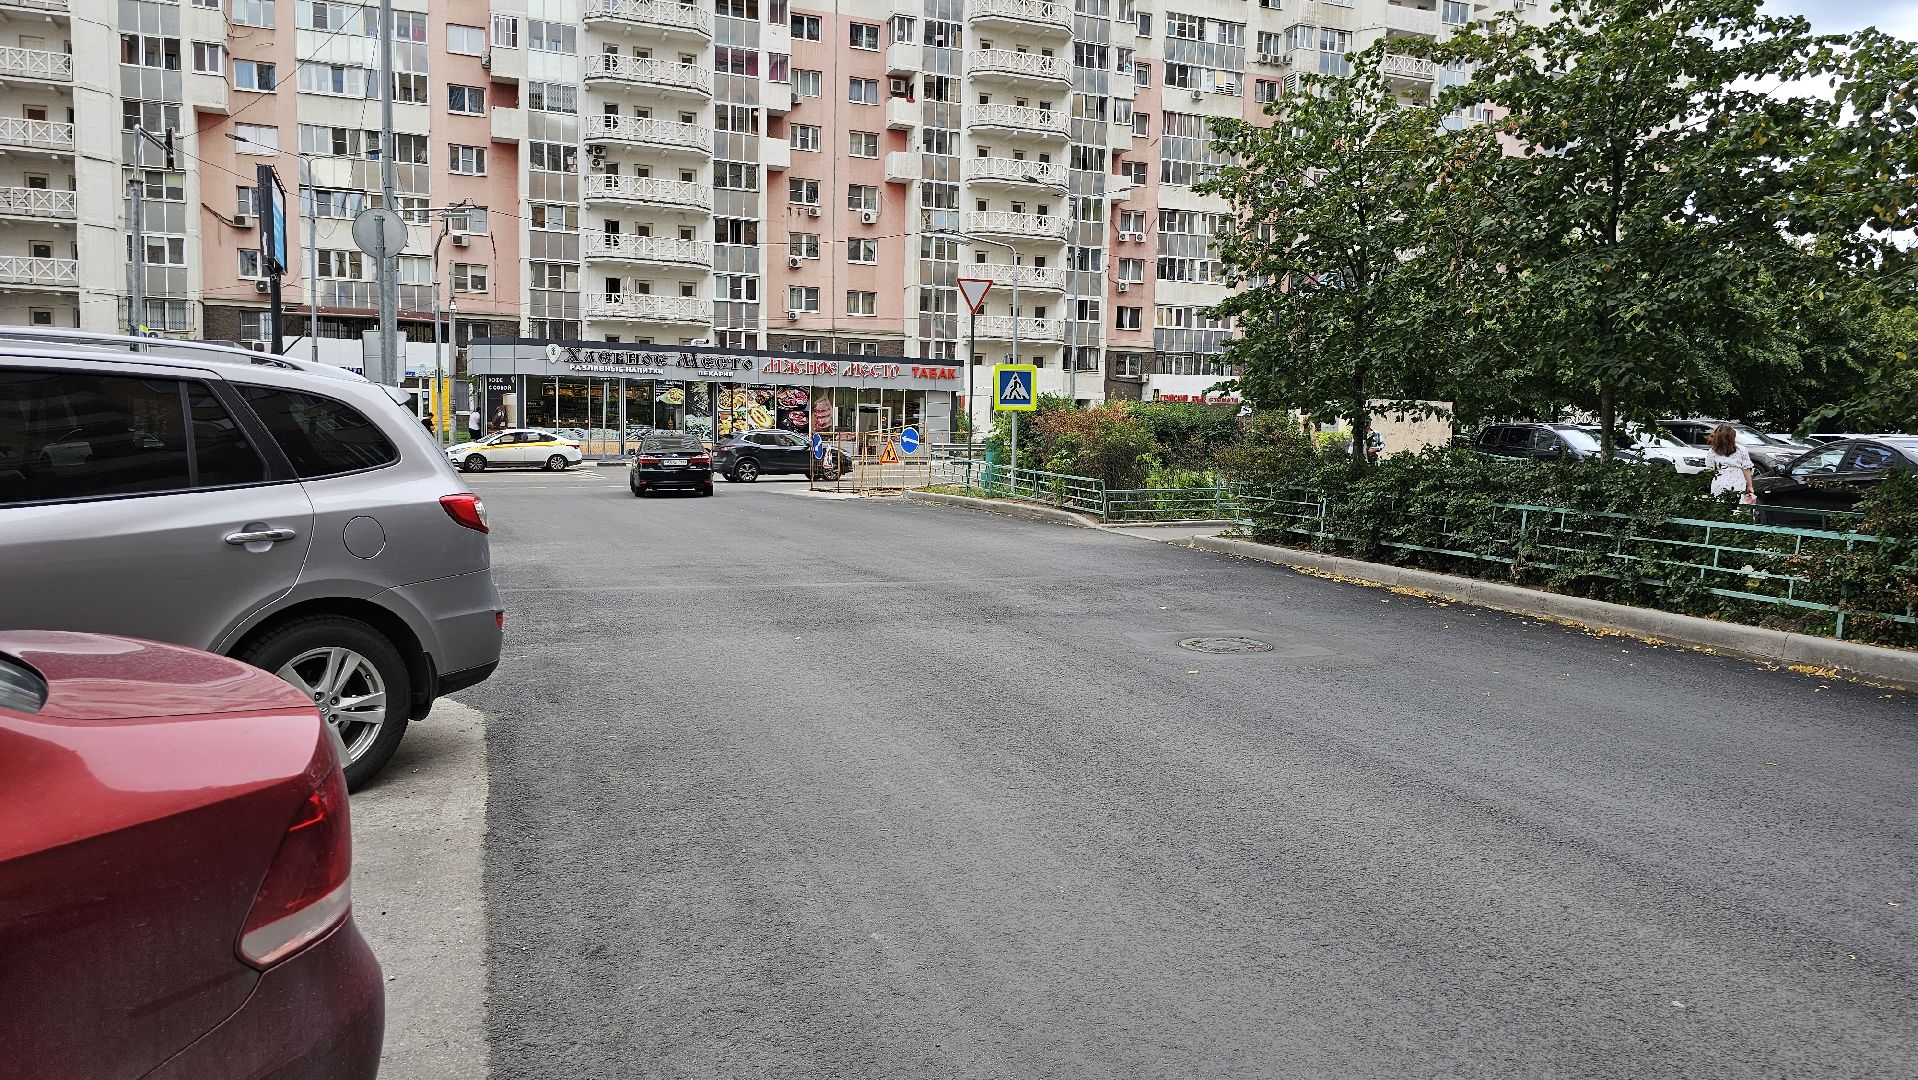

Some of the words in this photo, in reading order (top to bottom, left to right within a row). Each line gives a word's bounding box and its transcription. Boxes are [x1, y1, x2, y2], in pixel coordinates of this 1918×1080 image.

[569, 363, 624, 373] РАЗЛИВНЫЕ
[625, 366, 664, 375] НАПИТКИ
[911, 366, 956, 379] ТАБАК
